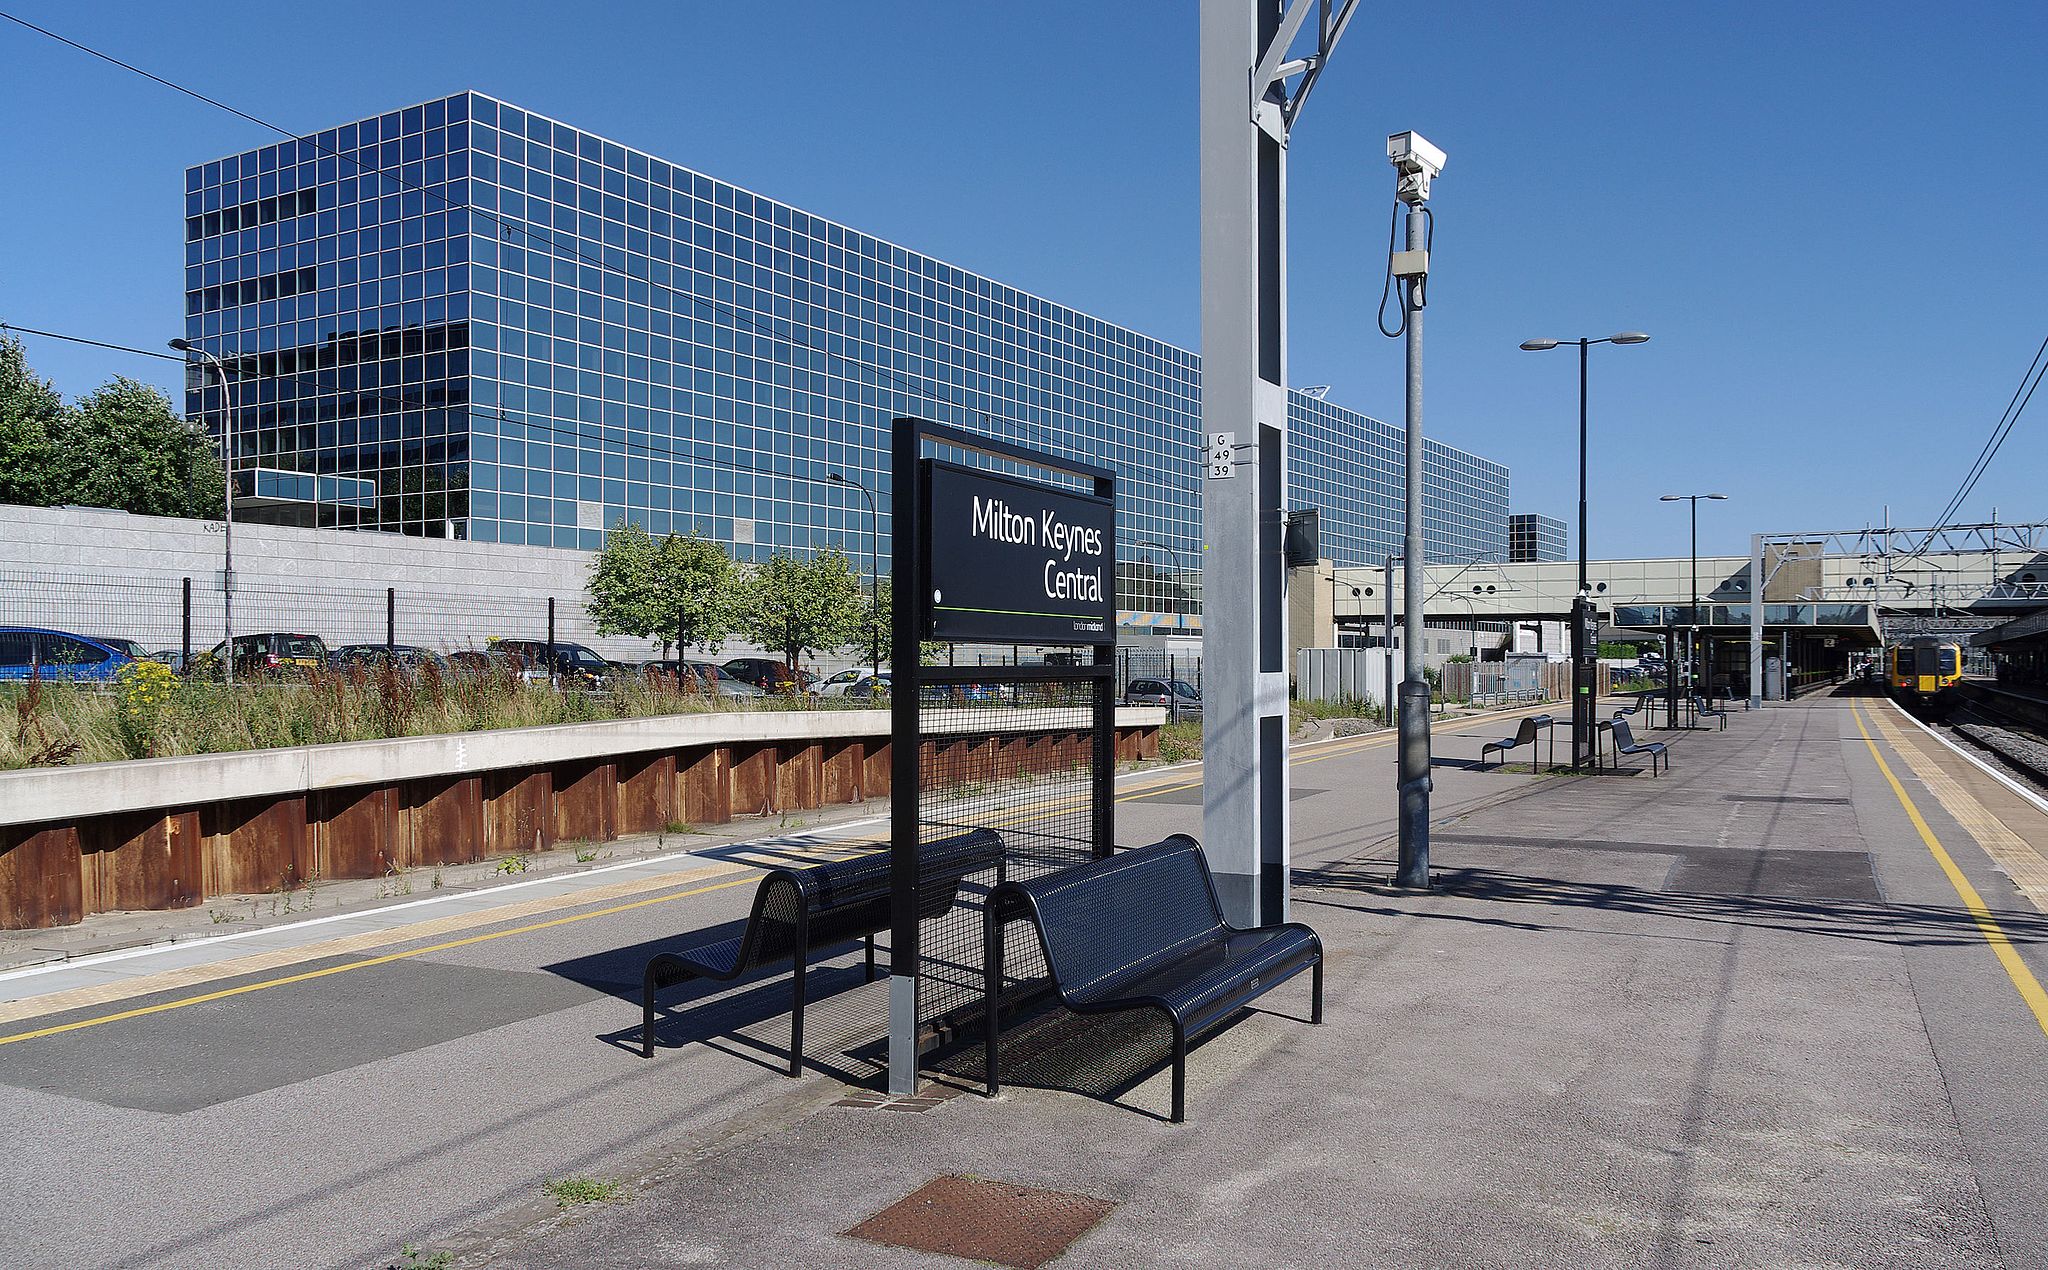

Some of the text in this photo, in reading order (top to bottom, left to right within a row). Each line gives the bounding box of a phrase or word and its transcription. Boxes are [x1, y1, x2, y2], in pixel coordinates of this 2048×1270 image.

[1217, 434, 1225, 446] G
[1213, 449, 1230, 461] 49
[1214, 465, 1229, 477] 39
[972, 495, 1102, 562] Milton Keynes
[1044, 558, 1104, 603] Central
